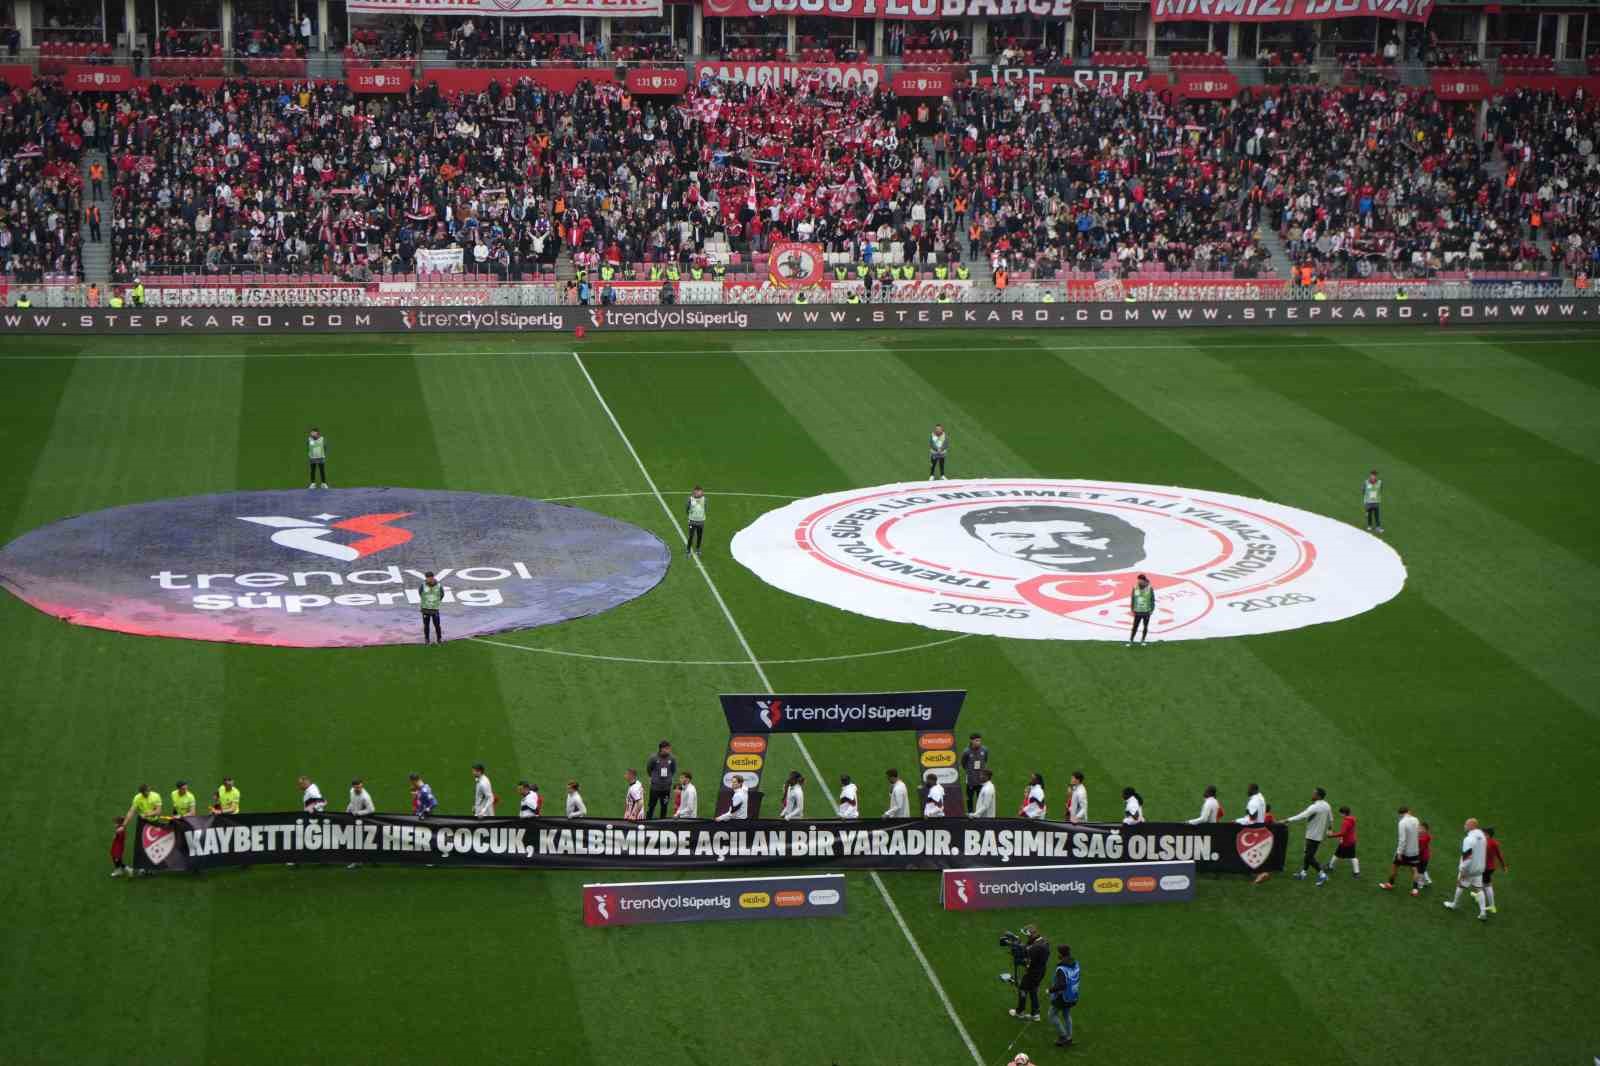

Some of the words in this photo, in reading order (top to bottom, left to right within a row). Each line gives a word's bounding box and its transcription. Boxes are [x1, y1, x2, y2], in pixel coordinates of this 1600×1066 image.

[419, 310, 498, 328] trendyol
[607, 309, 684, 328] trendyol
[937, 489, 1107, 501] MEHMET
[826, 507, 881, 539] SÜPER
[1180, 506, 1271, 541] YILMAZ
[1206, 542, 1278, 582] SEZONU
[151, 561, 533, 590] trendyol
[929, 602, 1030, 619] 2025
[1227, 592, 1317, 613] 2026
[784, 704, 867, 722] trendyol
[186, 817, 377, 857] KAYBETTİĞİMİZ
[382, 825, 432, 851] HER
[436, 826, 534, 858] ÇOCUK,
[539, 824, 691, 856] KALBİMİZDE
[695, 830, 787, 862] AÇILAN
[791, 825, 834, 857] BİR
[838, 830, 959, 857] YARADIR.
[964, 830, 1067, 862] BAŞIMIZ
[1072, 828, 1122, 859] SAĞ
[1127, 834, 1220, 861] OLSUN.
[978, 881, 1038, 896] trendyol
[619, 895, 682, 912] trendyol
